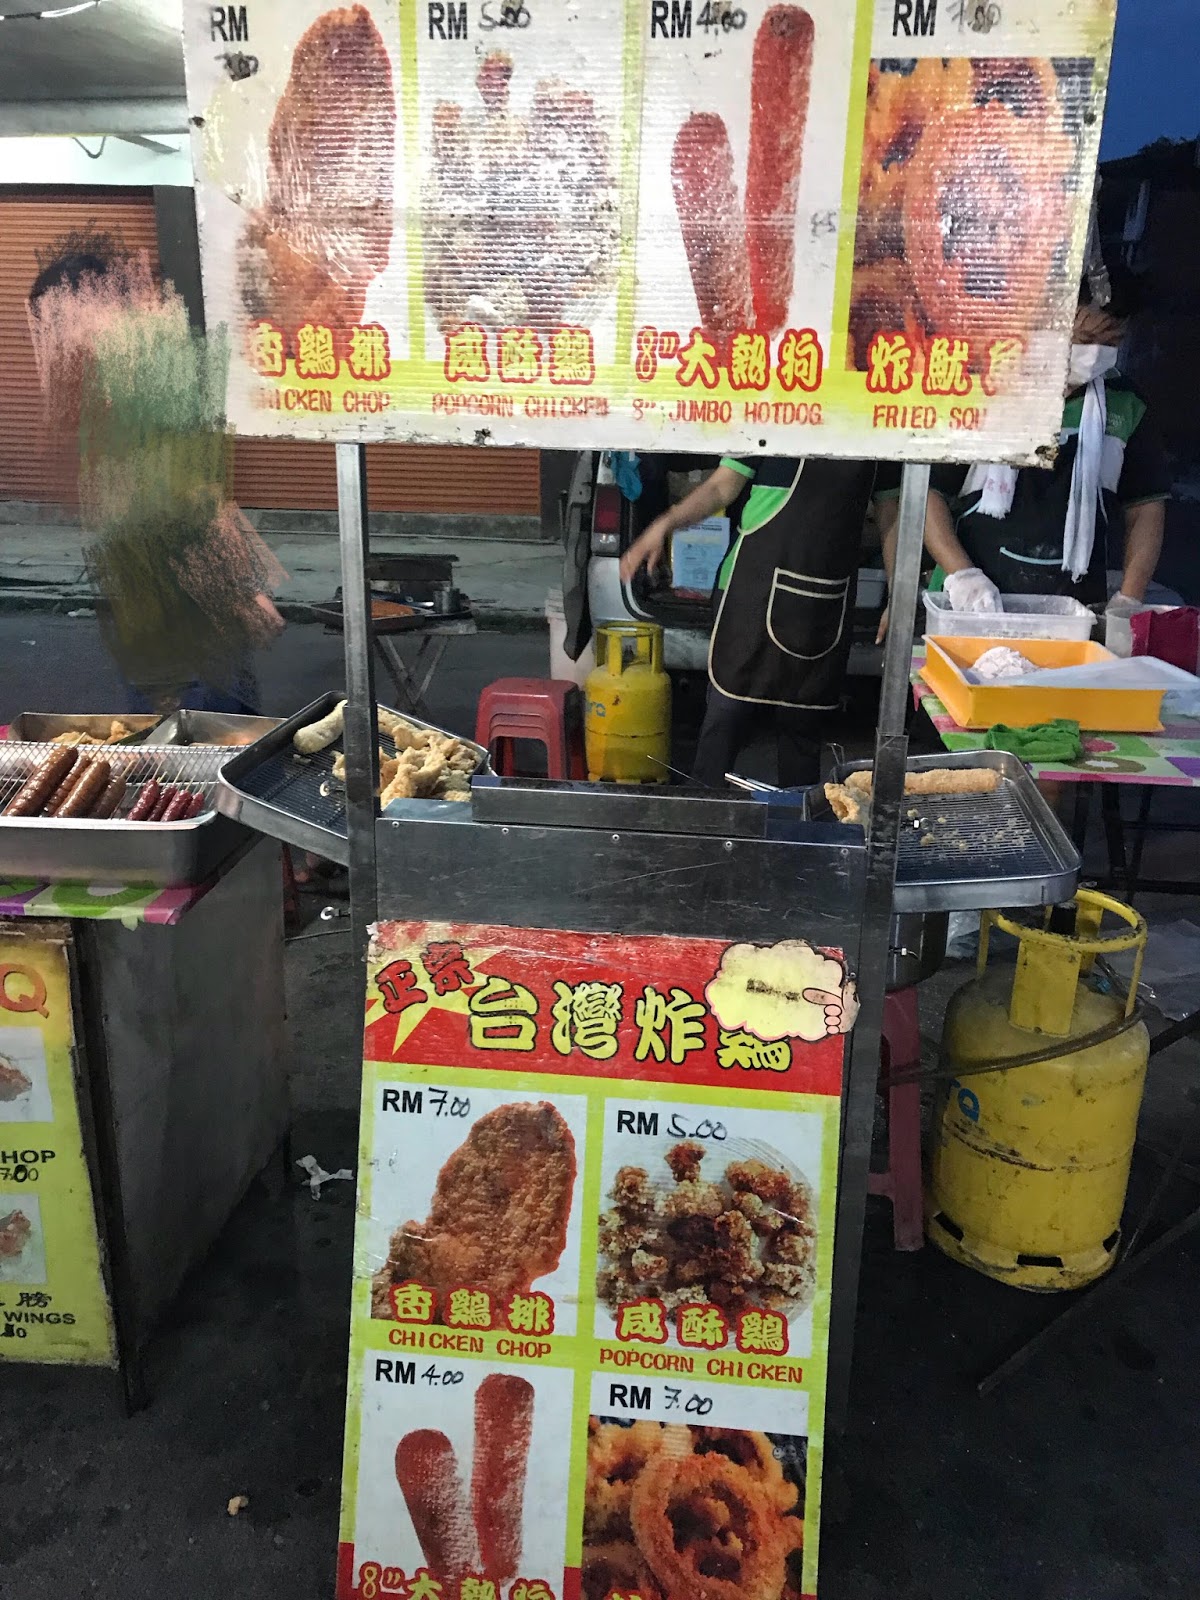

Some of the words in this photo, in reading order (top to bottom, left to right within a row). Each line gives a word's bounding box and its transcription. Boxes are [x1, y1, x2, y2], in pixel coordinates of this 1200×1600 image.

[210, 5, 248, 41] RM
[428, 2, 468, 40] RM
[651, 0, 692, 38] RM
[892, 0, 937, 36] RM
[343, 390, 391, 413] CHOP
[669, 400, 732, 424] JUMBO
[744, 402, 822, 425] HOTDOG
[873, 404, 936, 429] FRIED
[382, 1088, 422, 1114] RM
[429, 1087, 471, 1119] 7.00
[617, 1110, 659, 1137] RM
[666, 1113, 728, 1141] 5.00
[4, 1311, 76, 1325] WINGS
[388, 1329, 484, 1354] CHICKEN
[496, 1338, 552, 1358] CHOP
[375, 1359, 416, 1385] RM
[421, 1364, 464, 1387] 4.00
[600, 1348, 694, 1374] POPCORN
[707, 1358, 803, 1384] CHICKEN
[610, 1384, 652, 1410] RM
[664, 1386, 714, 1416] 7.00
